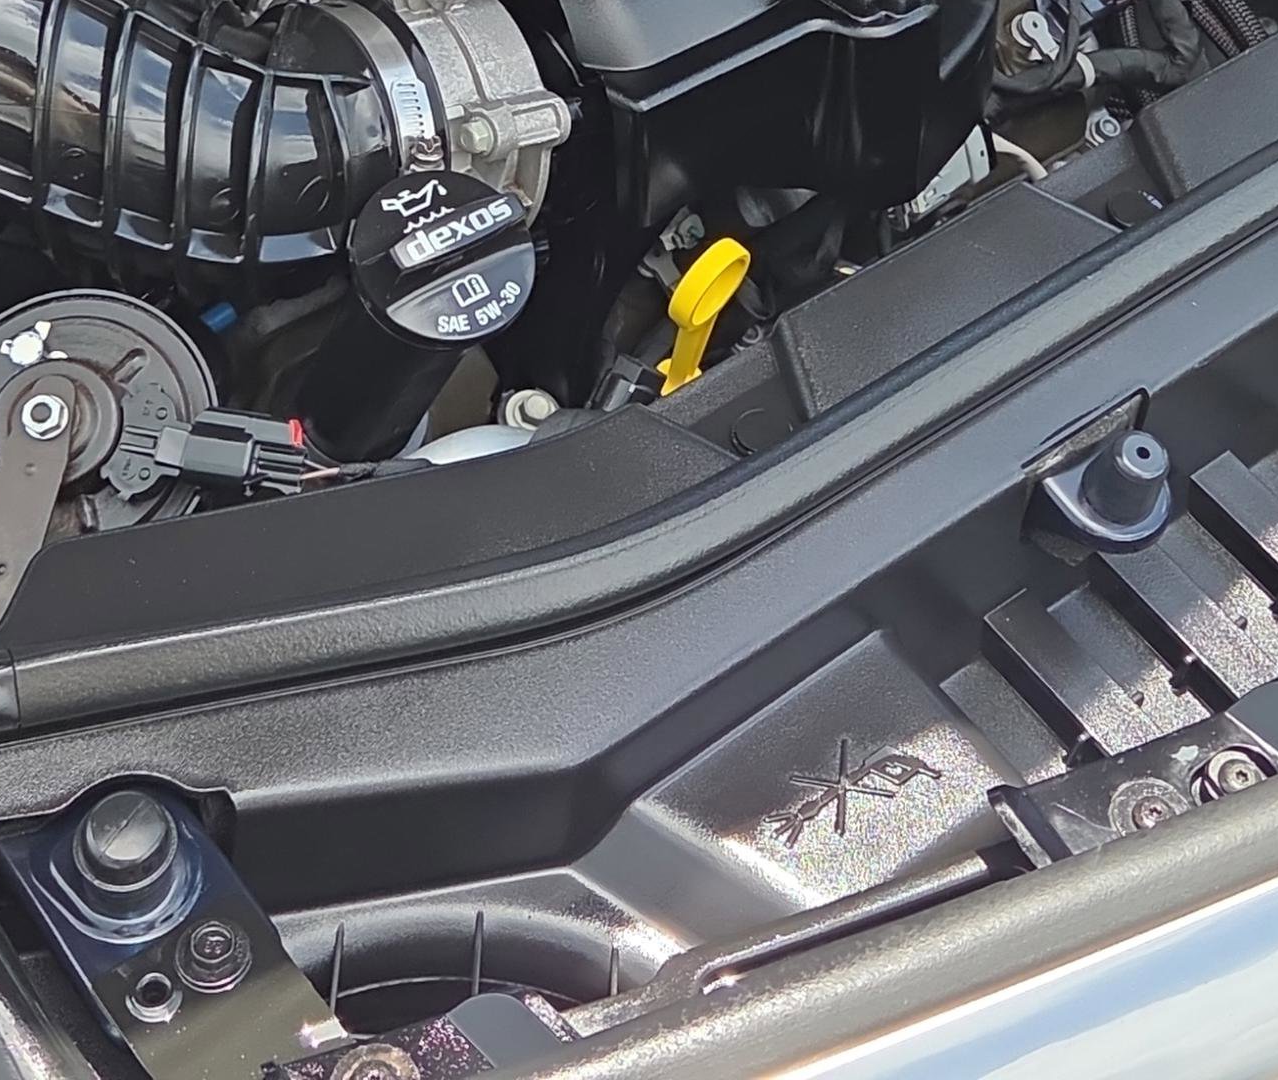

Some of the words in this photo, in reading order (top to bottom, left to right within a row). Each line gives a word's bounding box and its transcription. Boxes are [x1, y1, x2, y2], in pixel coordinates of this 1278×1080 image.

[406, 198, 514, 262] dexos
[437, 313, 472, 333] SAE
[474, 281, 521, 326] 5W-30
